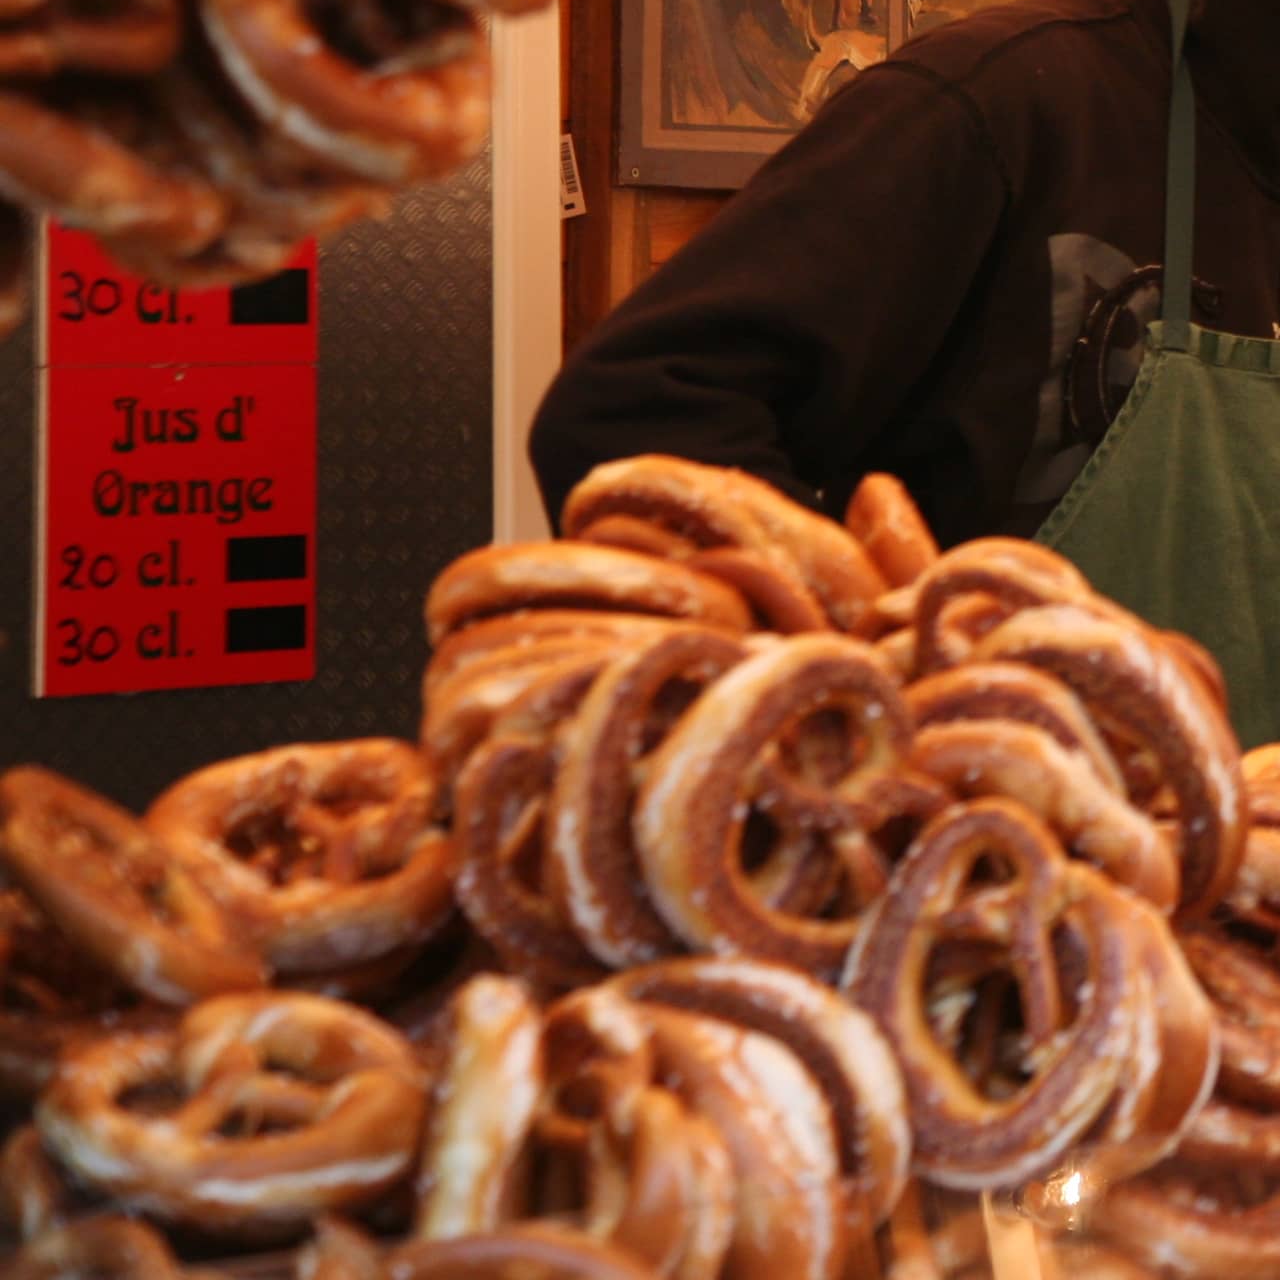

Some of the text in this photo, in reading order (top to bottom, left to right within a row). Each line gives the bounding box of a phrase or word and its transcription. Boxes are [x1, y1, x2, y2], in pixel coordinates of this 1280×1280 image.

[58, 272, 122, 321] 30
[112, 396, 256, 453] Jus d'
[93, 470, 274, 524] Orange
[56, 619, 121, 665] 30
